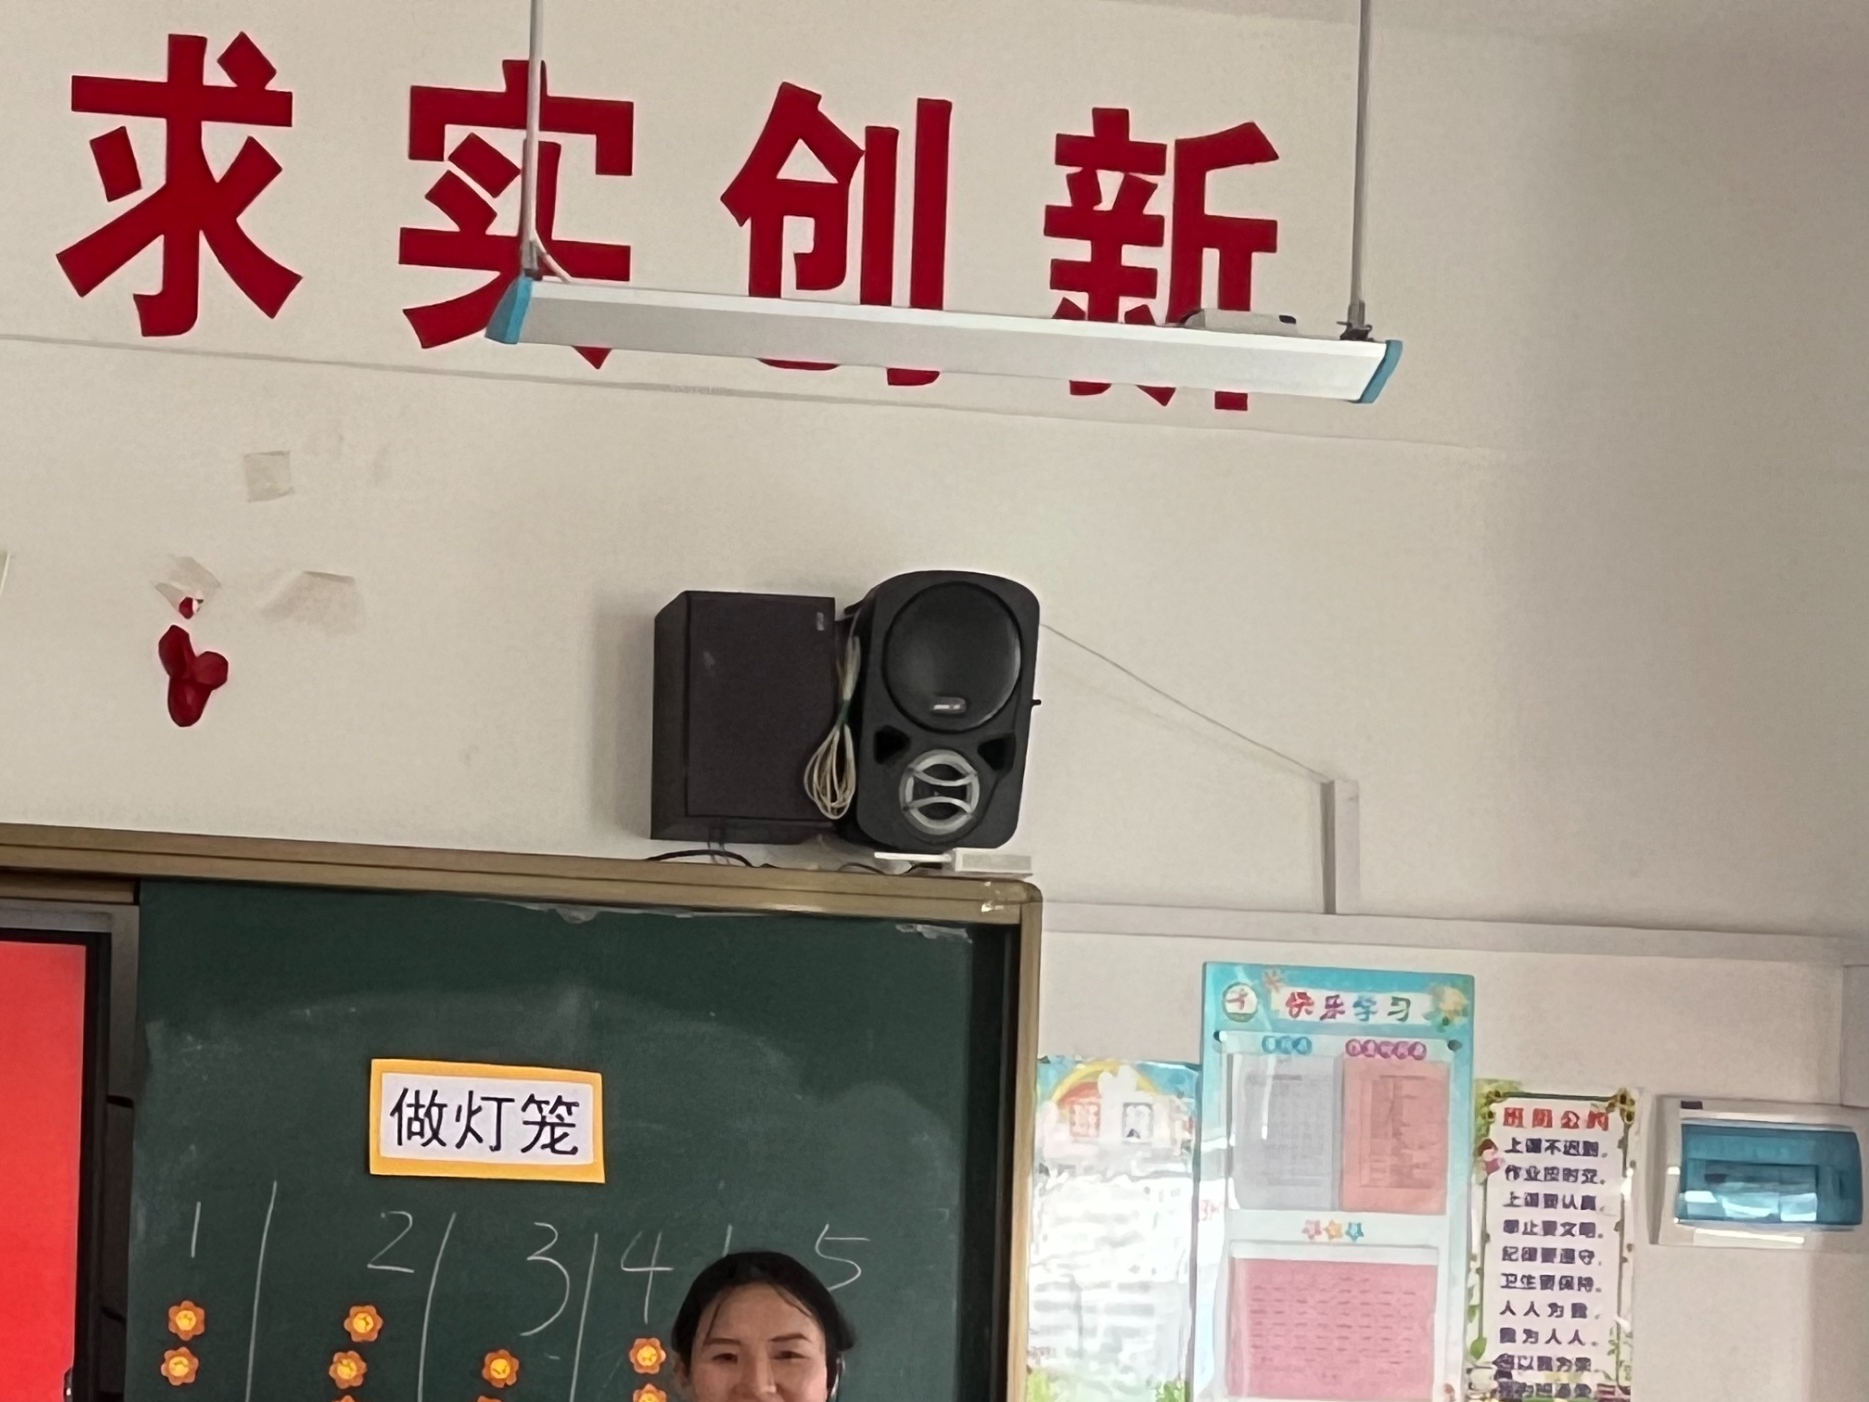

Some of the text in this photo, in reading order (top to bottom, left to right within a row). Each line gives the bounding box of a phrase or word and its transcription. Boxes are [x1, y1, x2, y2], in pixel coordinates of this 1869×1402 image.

[56, 31, 1279, 411] 求实创新
[1285, 991, 1412, 1021] 快乐学习
[389, 1087, 581, 1156] 做灯笼
[190, 1201, 201, 1258] 1
[367, 1210, 415, 1274] 2
[814, 1223, 871, 1291] 5
[519, 1221, 570, 1336] 3
[619, 1231, 674, 1324] 4
